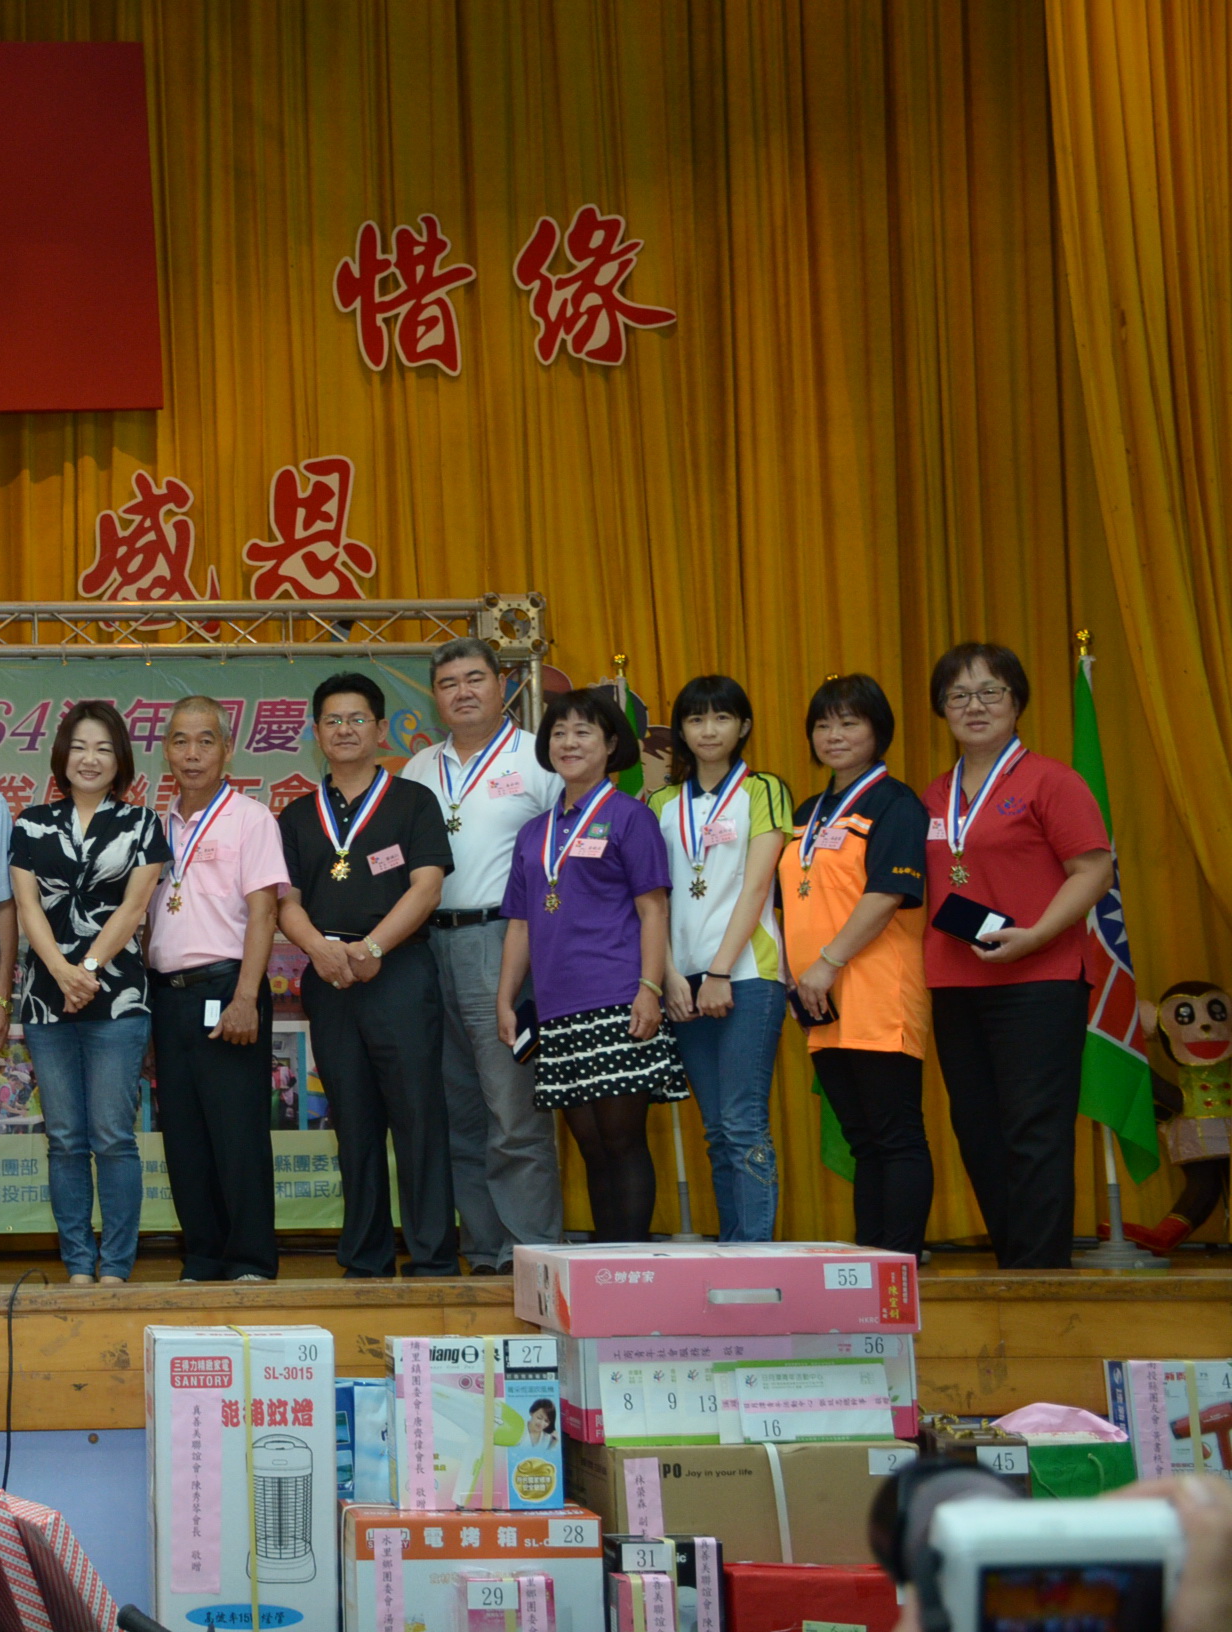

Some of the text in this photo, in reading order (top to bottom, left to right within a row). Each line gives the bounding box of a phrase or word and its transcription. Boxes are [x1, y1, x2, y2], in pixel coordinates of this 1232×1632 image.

[333, 203, 677, 377] 惜緣
[838, 1269, 858, 1286] 55
[298, 1344, 318, 1362] 30
[864, 1337, 884, 1354] 56
[522, 1346, 543, 1364] 27
[174, 1376, 230, 1387] SANTORY
[264, 1366, 313, 1380] SL-3015
[623, 1393, 634, 1411] 8
[668, 1392, 677, 1410] 9
[699, 1395, 718, 1413] 13
[763, 1419, 782, 1438] 16
[887, 1454, 898, 1471] 2
[993, 1452, 1015, 1471] 45
[658, 1464, 682, 1478] PO
[685, 1470, 702, 1478] Joy
[738, 1468, 753, 1476] life
[424, 1526, 518, 1547] 電烤箱
[563, 1525, 584, 1544] 28
[637, 1549, 656, 1568] 31
[482, 1587, 504, 1606] 29
